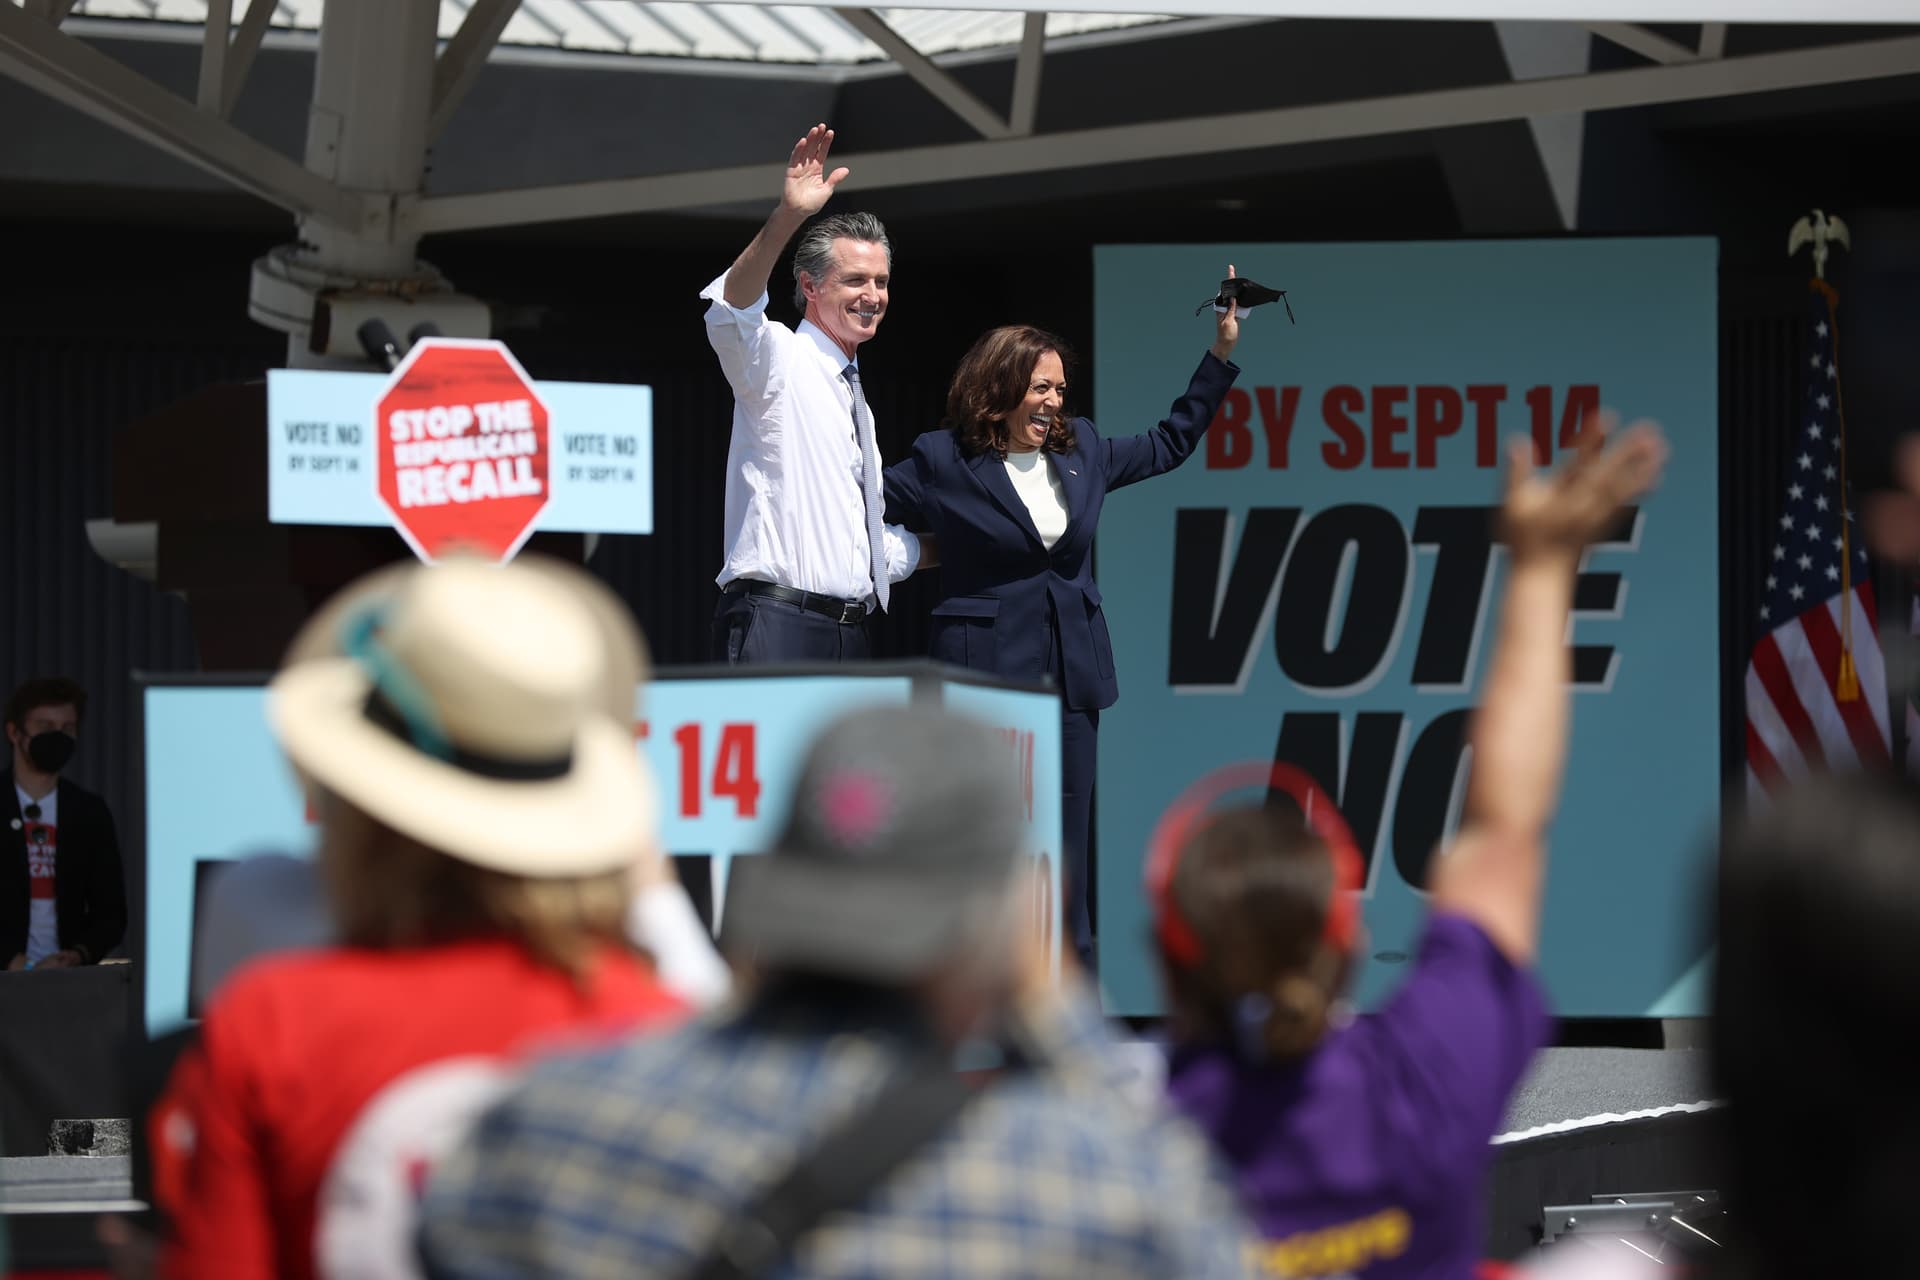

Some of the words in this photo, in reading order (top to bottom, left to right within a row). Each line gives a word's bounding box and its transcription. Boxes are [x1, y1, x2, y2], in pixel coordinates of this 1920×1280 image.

[284, 421, 328, 446] VOTE
[336, 423, 362, 446] NO
[389, 405, 473, 441] STOP
[473, 399, 532, 433] THE
[1206, 385, 1302, 470] BY
[1321, 384, 1507, 470] SEPT
[1525, 384, 1606, 468] 14
[393, 430, 537, 468] REPUBLICAN
[563, 432, 606, 456] VOTE
[613, 434, 638, 457] NO
[396, 456, 542, 509] RECALL
[1168, 503, 1643, 696] VOTE
[673, 721, 761, 821] 14
